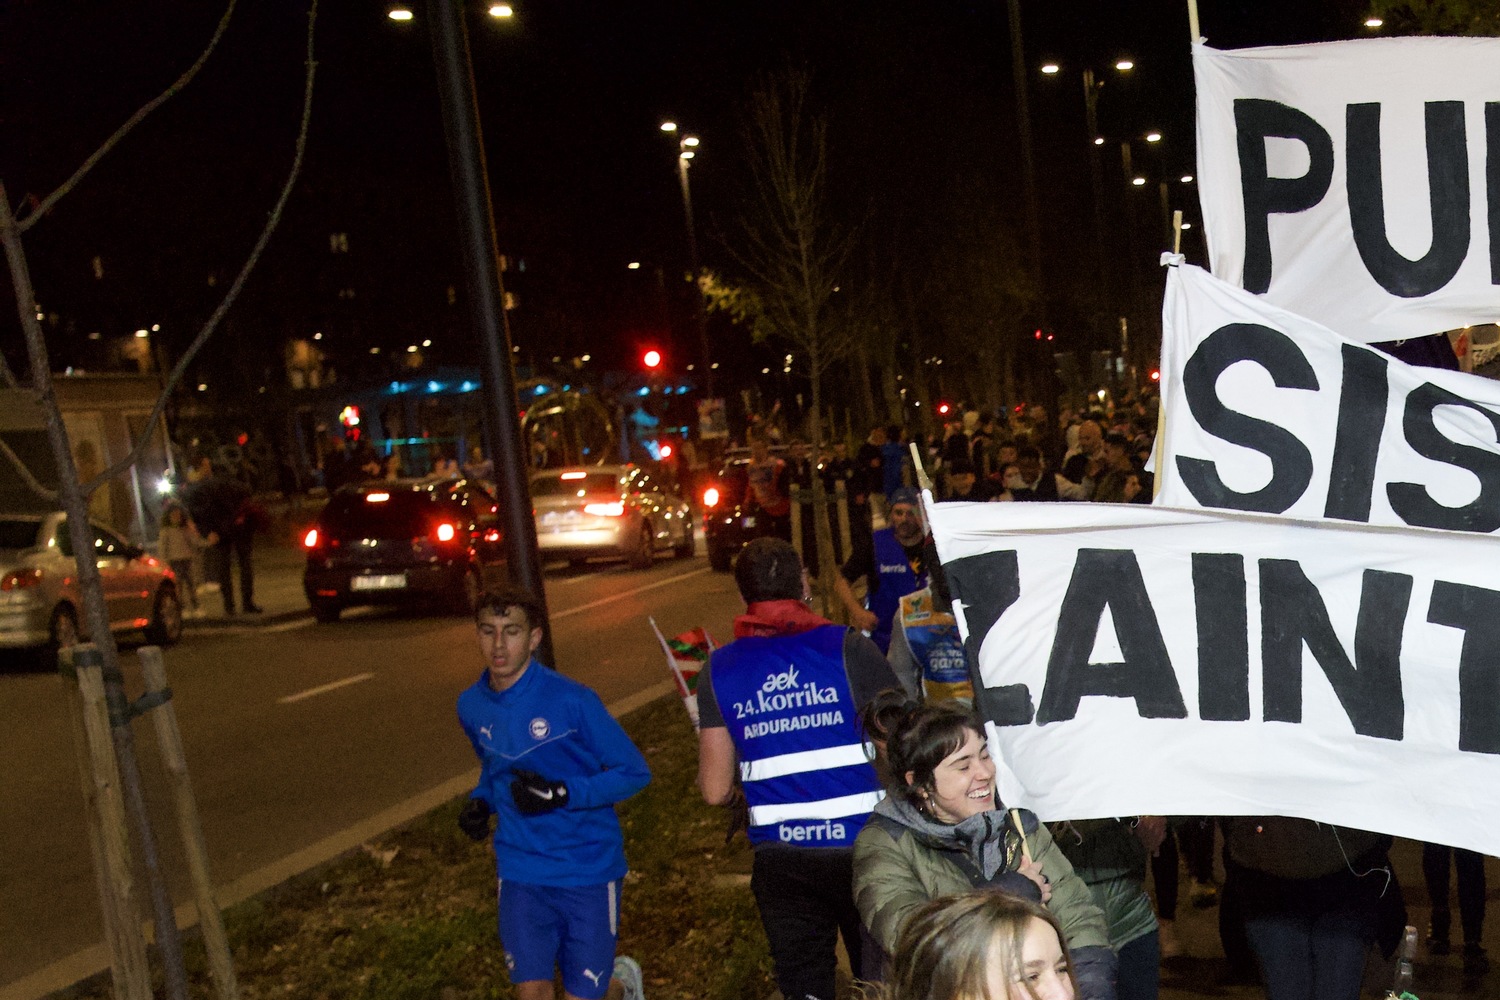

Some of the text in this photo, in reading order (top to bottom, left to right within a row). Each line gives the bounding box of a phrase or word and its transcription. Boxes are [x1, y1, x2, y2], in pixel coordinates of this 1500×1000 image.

[762, 664, 801, 693] aek
[733, 682, 839, 720] 24.korrika
[744, 710, 844, 740] ARDURADUNA
[779, 820, 846, 842] berria
